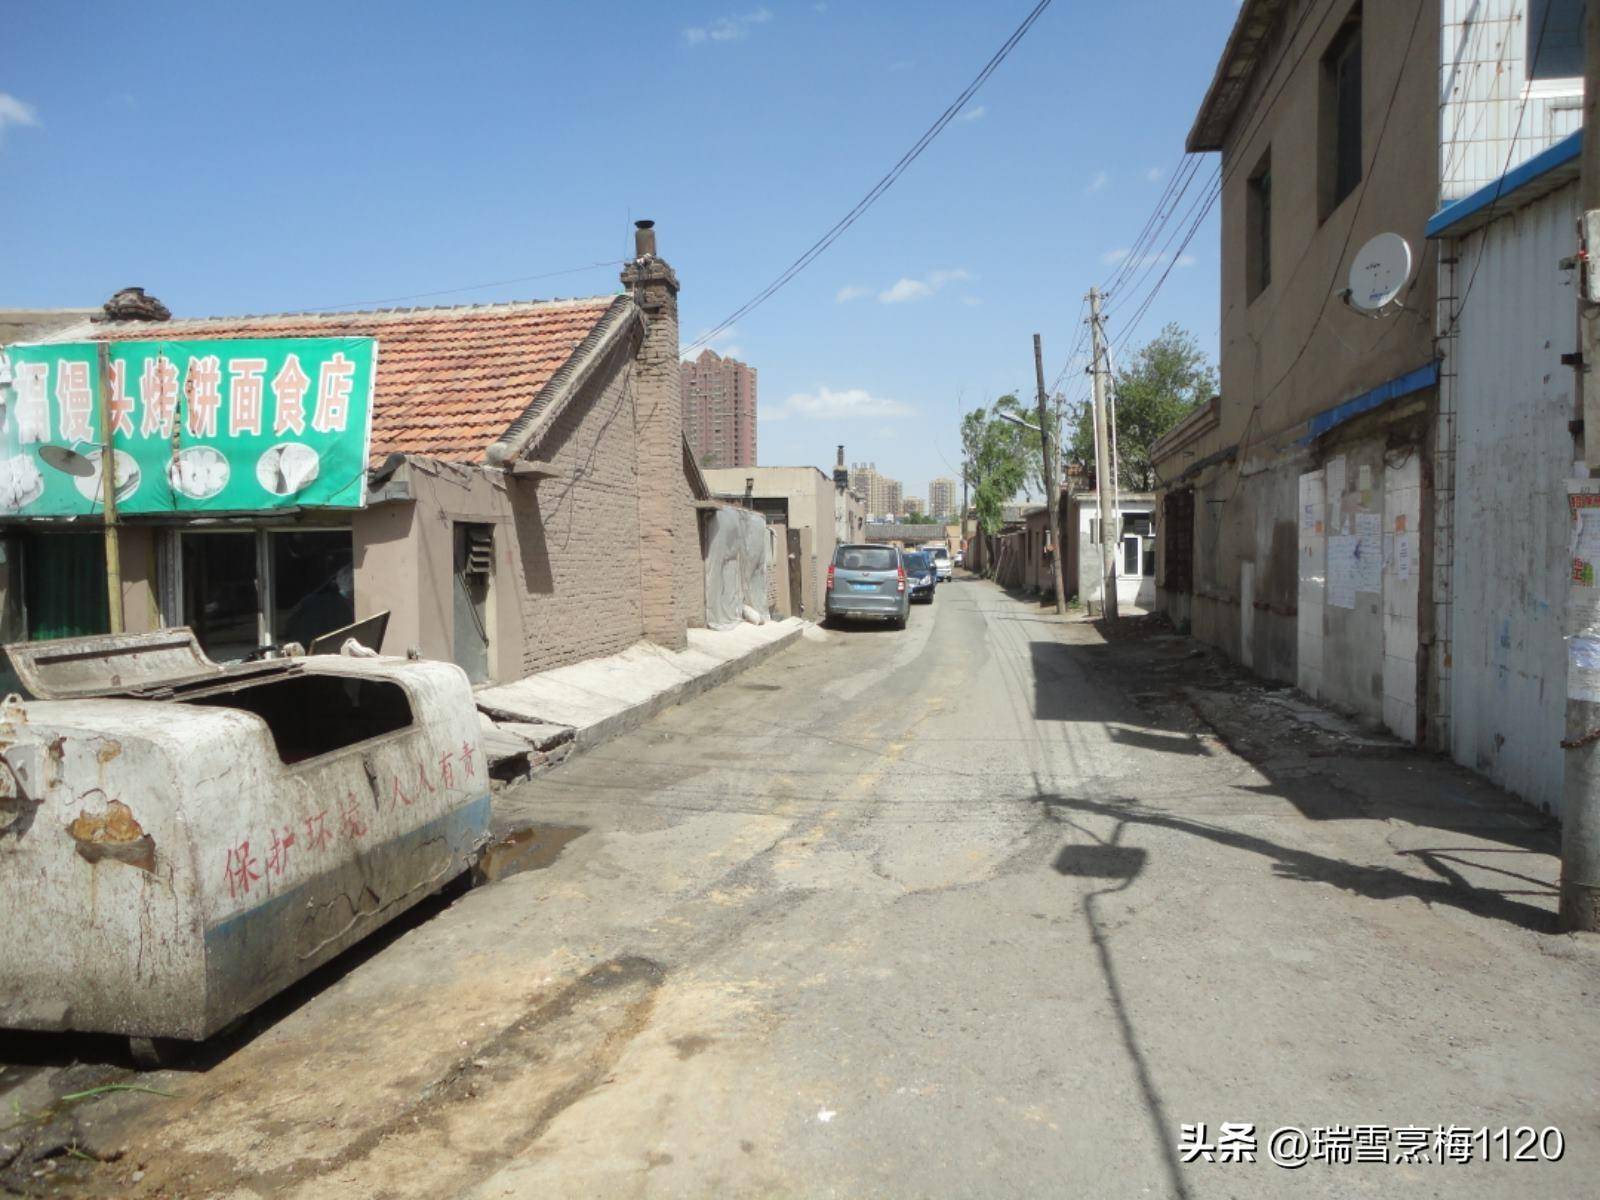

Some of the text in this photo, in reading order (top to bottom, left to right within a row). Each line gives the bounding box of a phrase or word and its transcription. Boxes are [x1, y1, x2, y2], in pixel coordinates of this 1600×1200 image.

[0, 352, 356, 443] 福馒头烤饼面食店
[224, 741, 475, 899] 保护环境 人人有责
